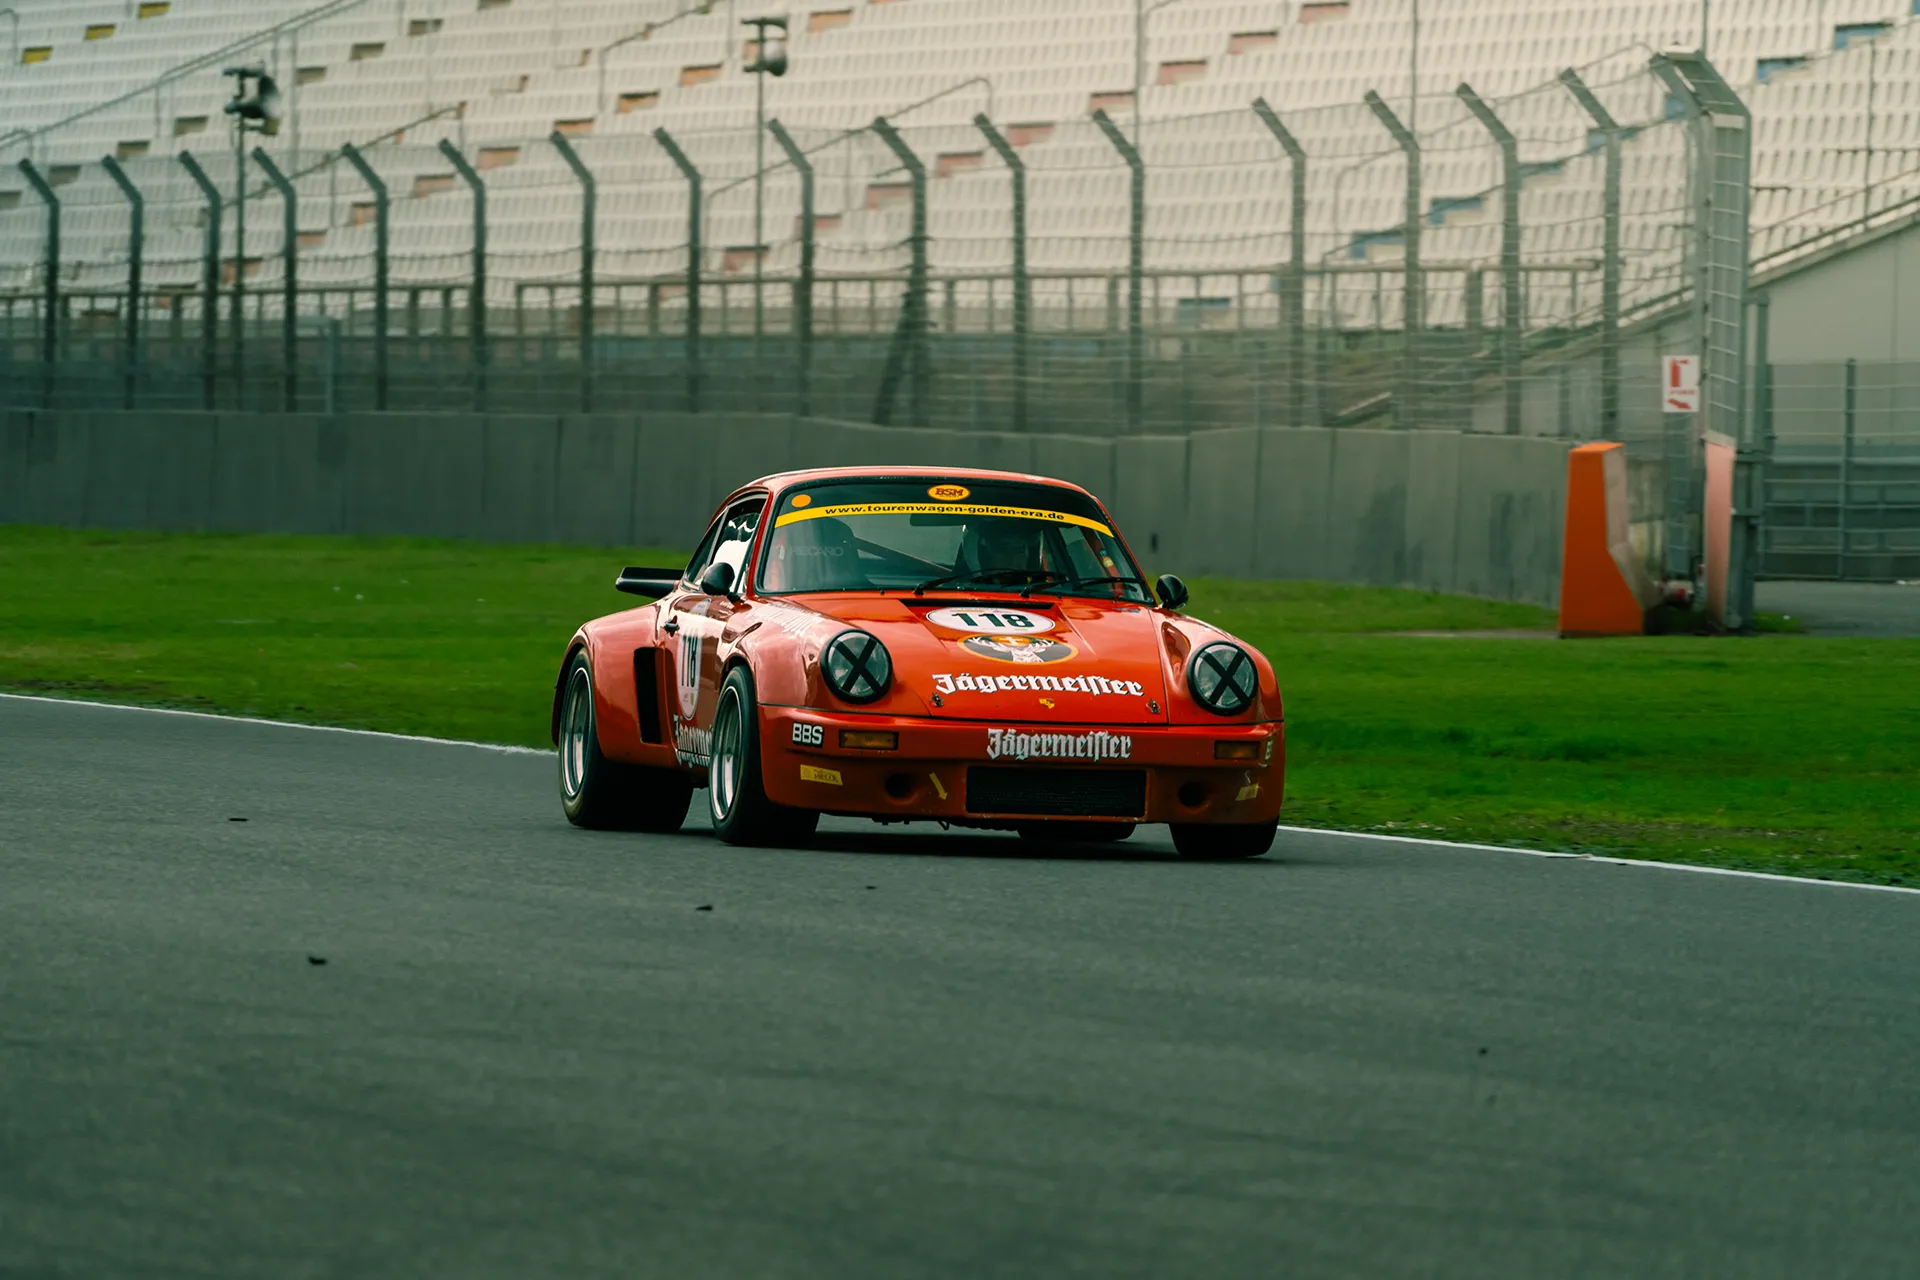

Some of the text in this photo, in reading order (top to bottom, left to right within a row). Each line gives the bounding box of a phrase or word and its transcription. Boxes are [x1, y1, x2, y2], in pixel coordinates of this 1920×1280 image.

[825, 504, 1065, 521] www.tourenwagen-golden-era.de
[951, 613, 1035, 628] 118
[792, 722, 824, 745] BBS
